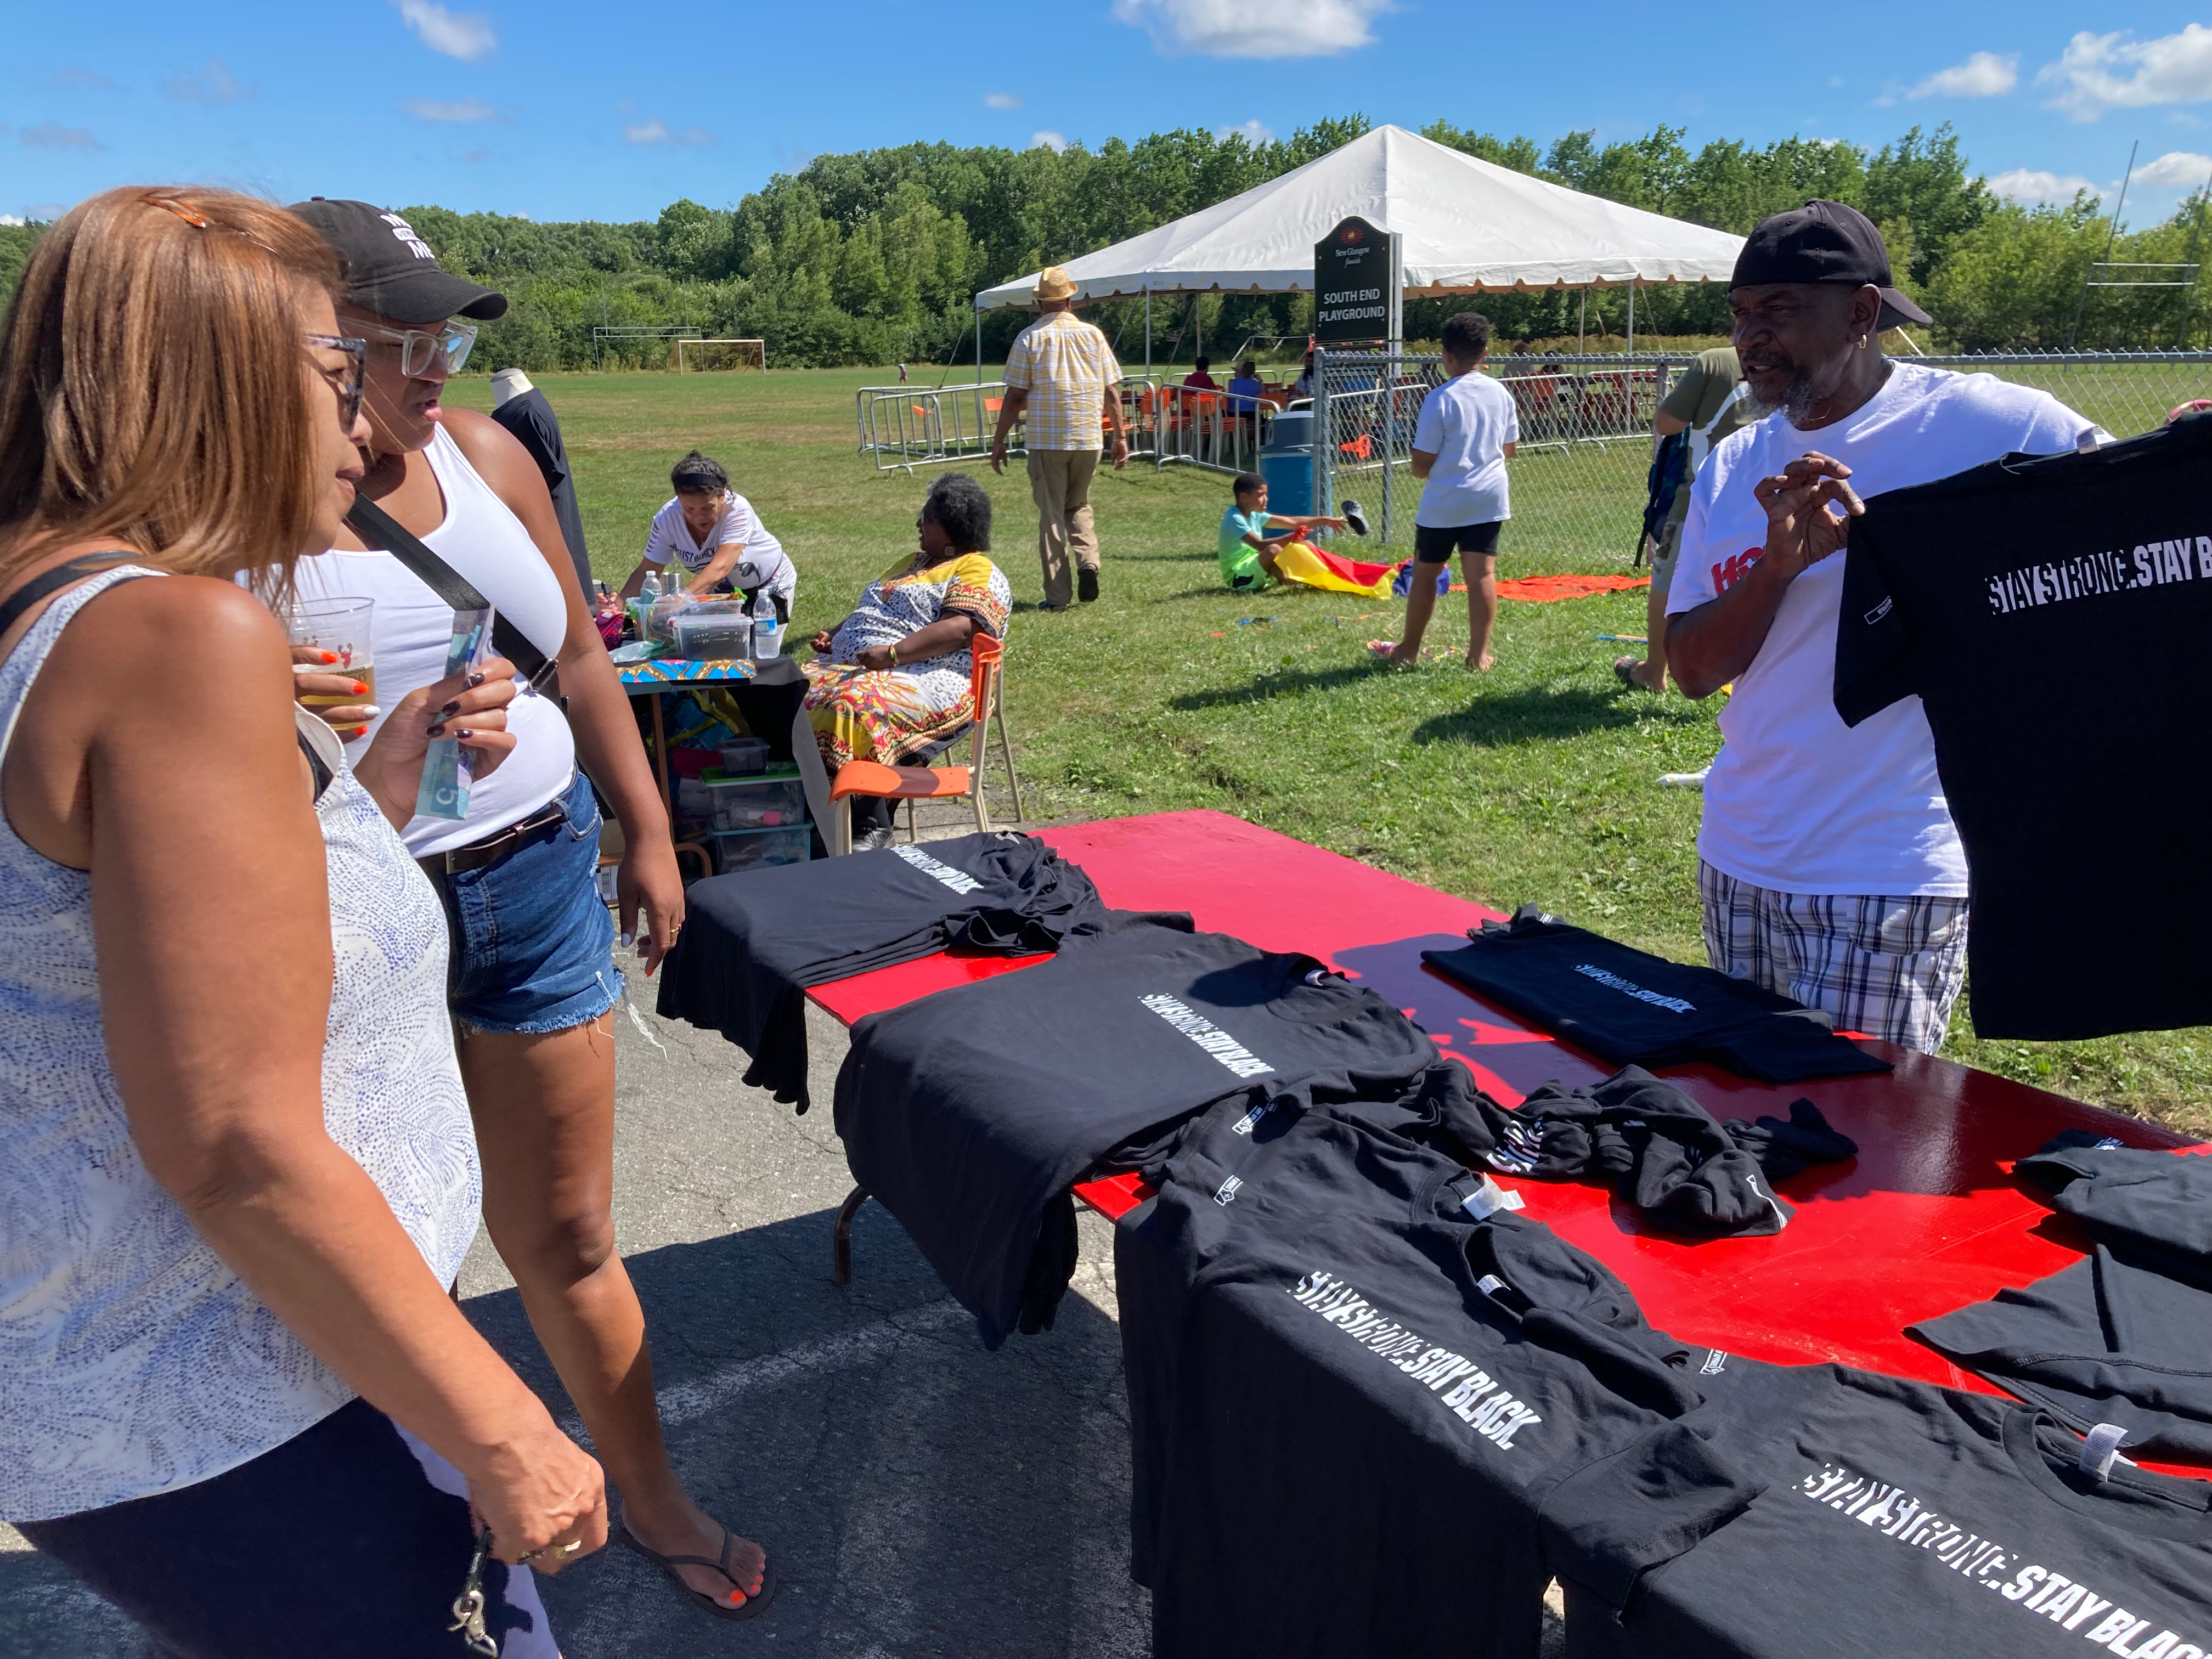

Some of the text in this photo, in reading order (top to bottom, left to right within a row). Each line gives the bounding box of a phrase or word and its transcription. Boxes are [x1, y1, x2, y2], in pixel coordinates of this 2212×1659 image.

[1324, 288, 1380, 304] SOUTH END
[1319, 306, 1385, 322] PLAYGROUND
[1440, 1370, 1542, 1451] BLACK
